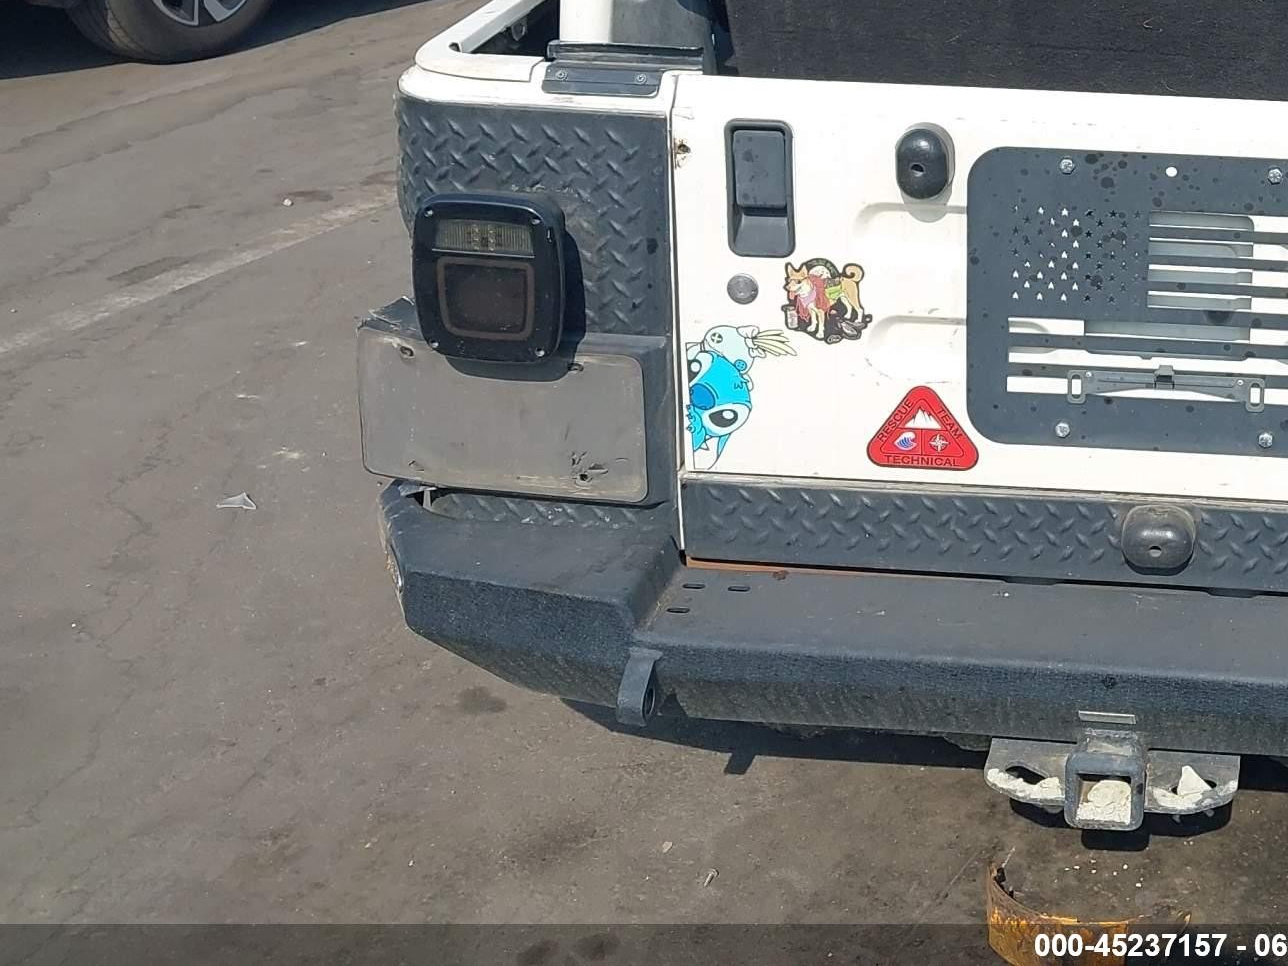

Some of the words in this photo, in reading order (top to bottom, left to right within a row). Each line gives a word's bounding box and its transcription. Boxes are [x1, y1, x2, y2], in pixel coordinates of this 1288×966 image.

[877, 398, 914, 442] RESCUE
[937, 405, 963, 440] TEAM
[884, 454, 961, 467] TECHNICAL
